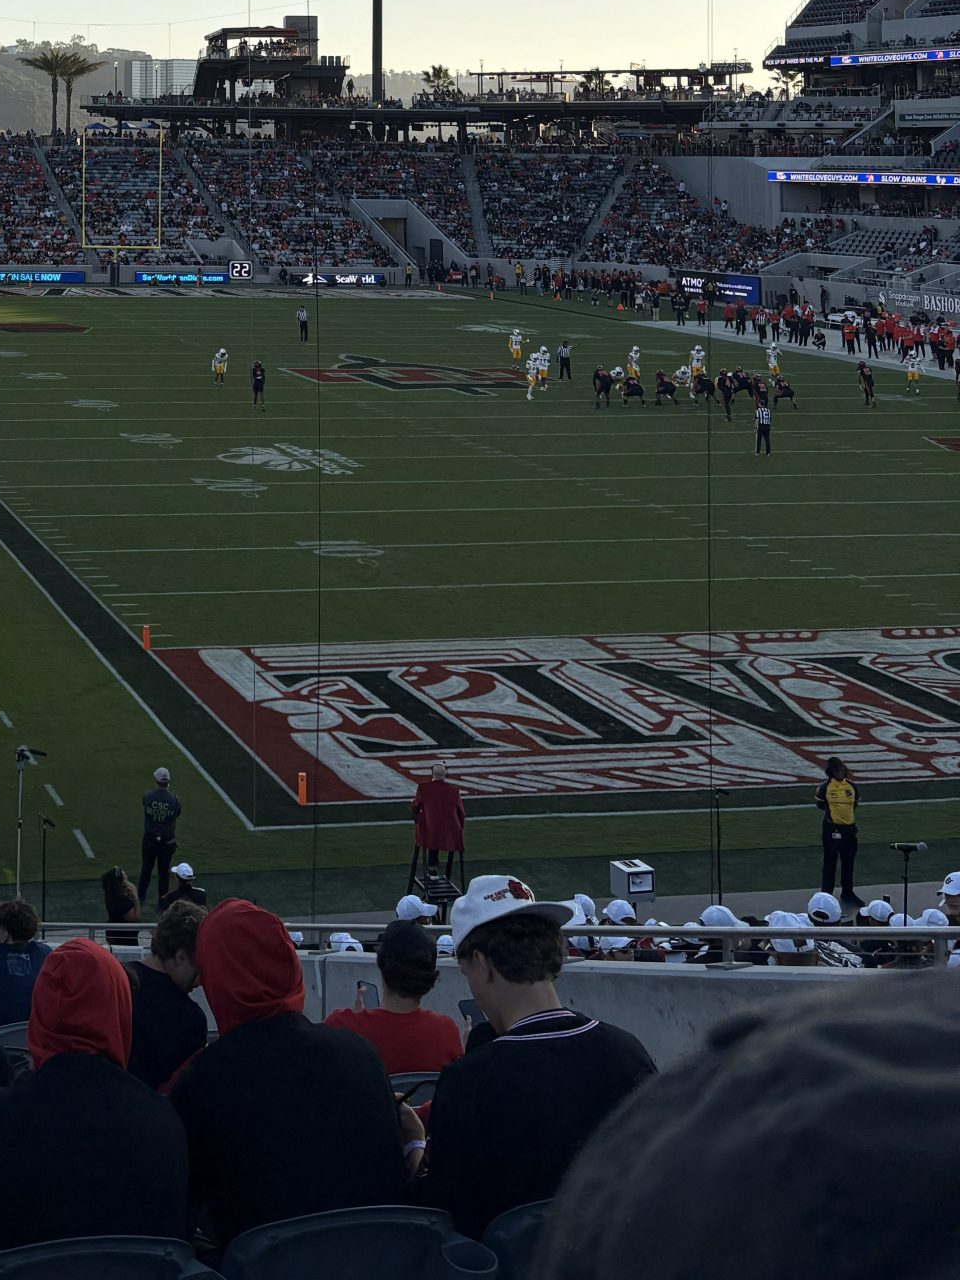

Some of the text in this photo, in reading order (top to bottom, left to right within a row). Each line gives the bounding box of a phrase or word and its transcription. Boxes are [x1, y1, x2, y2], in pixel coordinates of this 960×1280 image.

[858, 52, 928, 63] WHITEGLOVEGUYS.COM
[790, 174, 858, 182] WHITEGLOVEGUYS.COM
[232, 263, 249, 277] 22
[888, 290, 921, 303] Snapdragon
[151, 801, 169, 810] CSC
